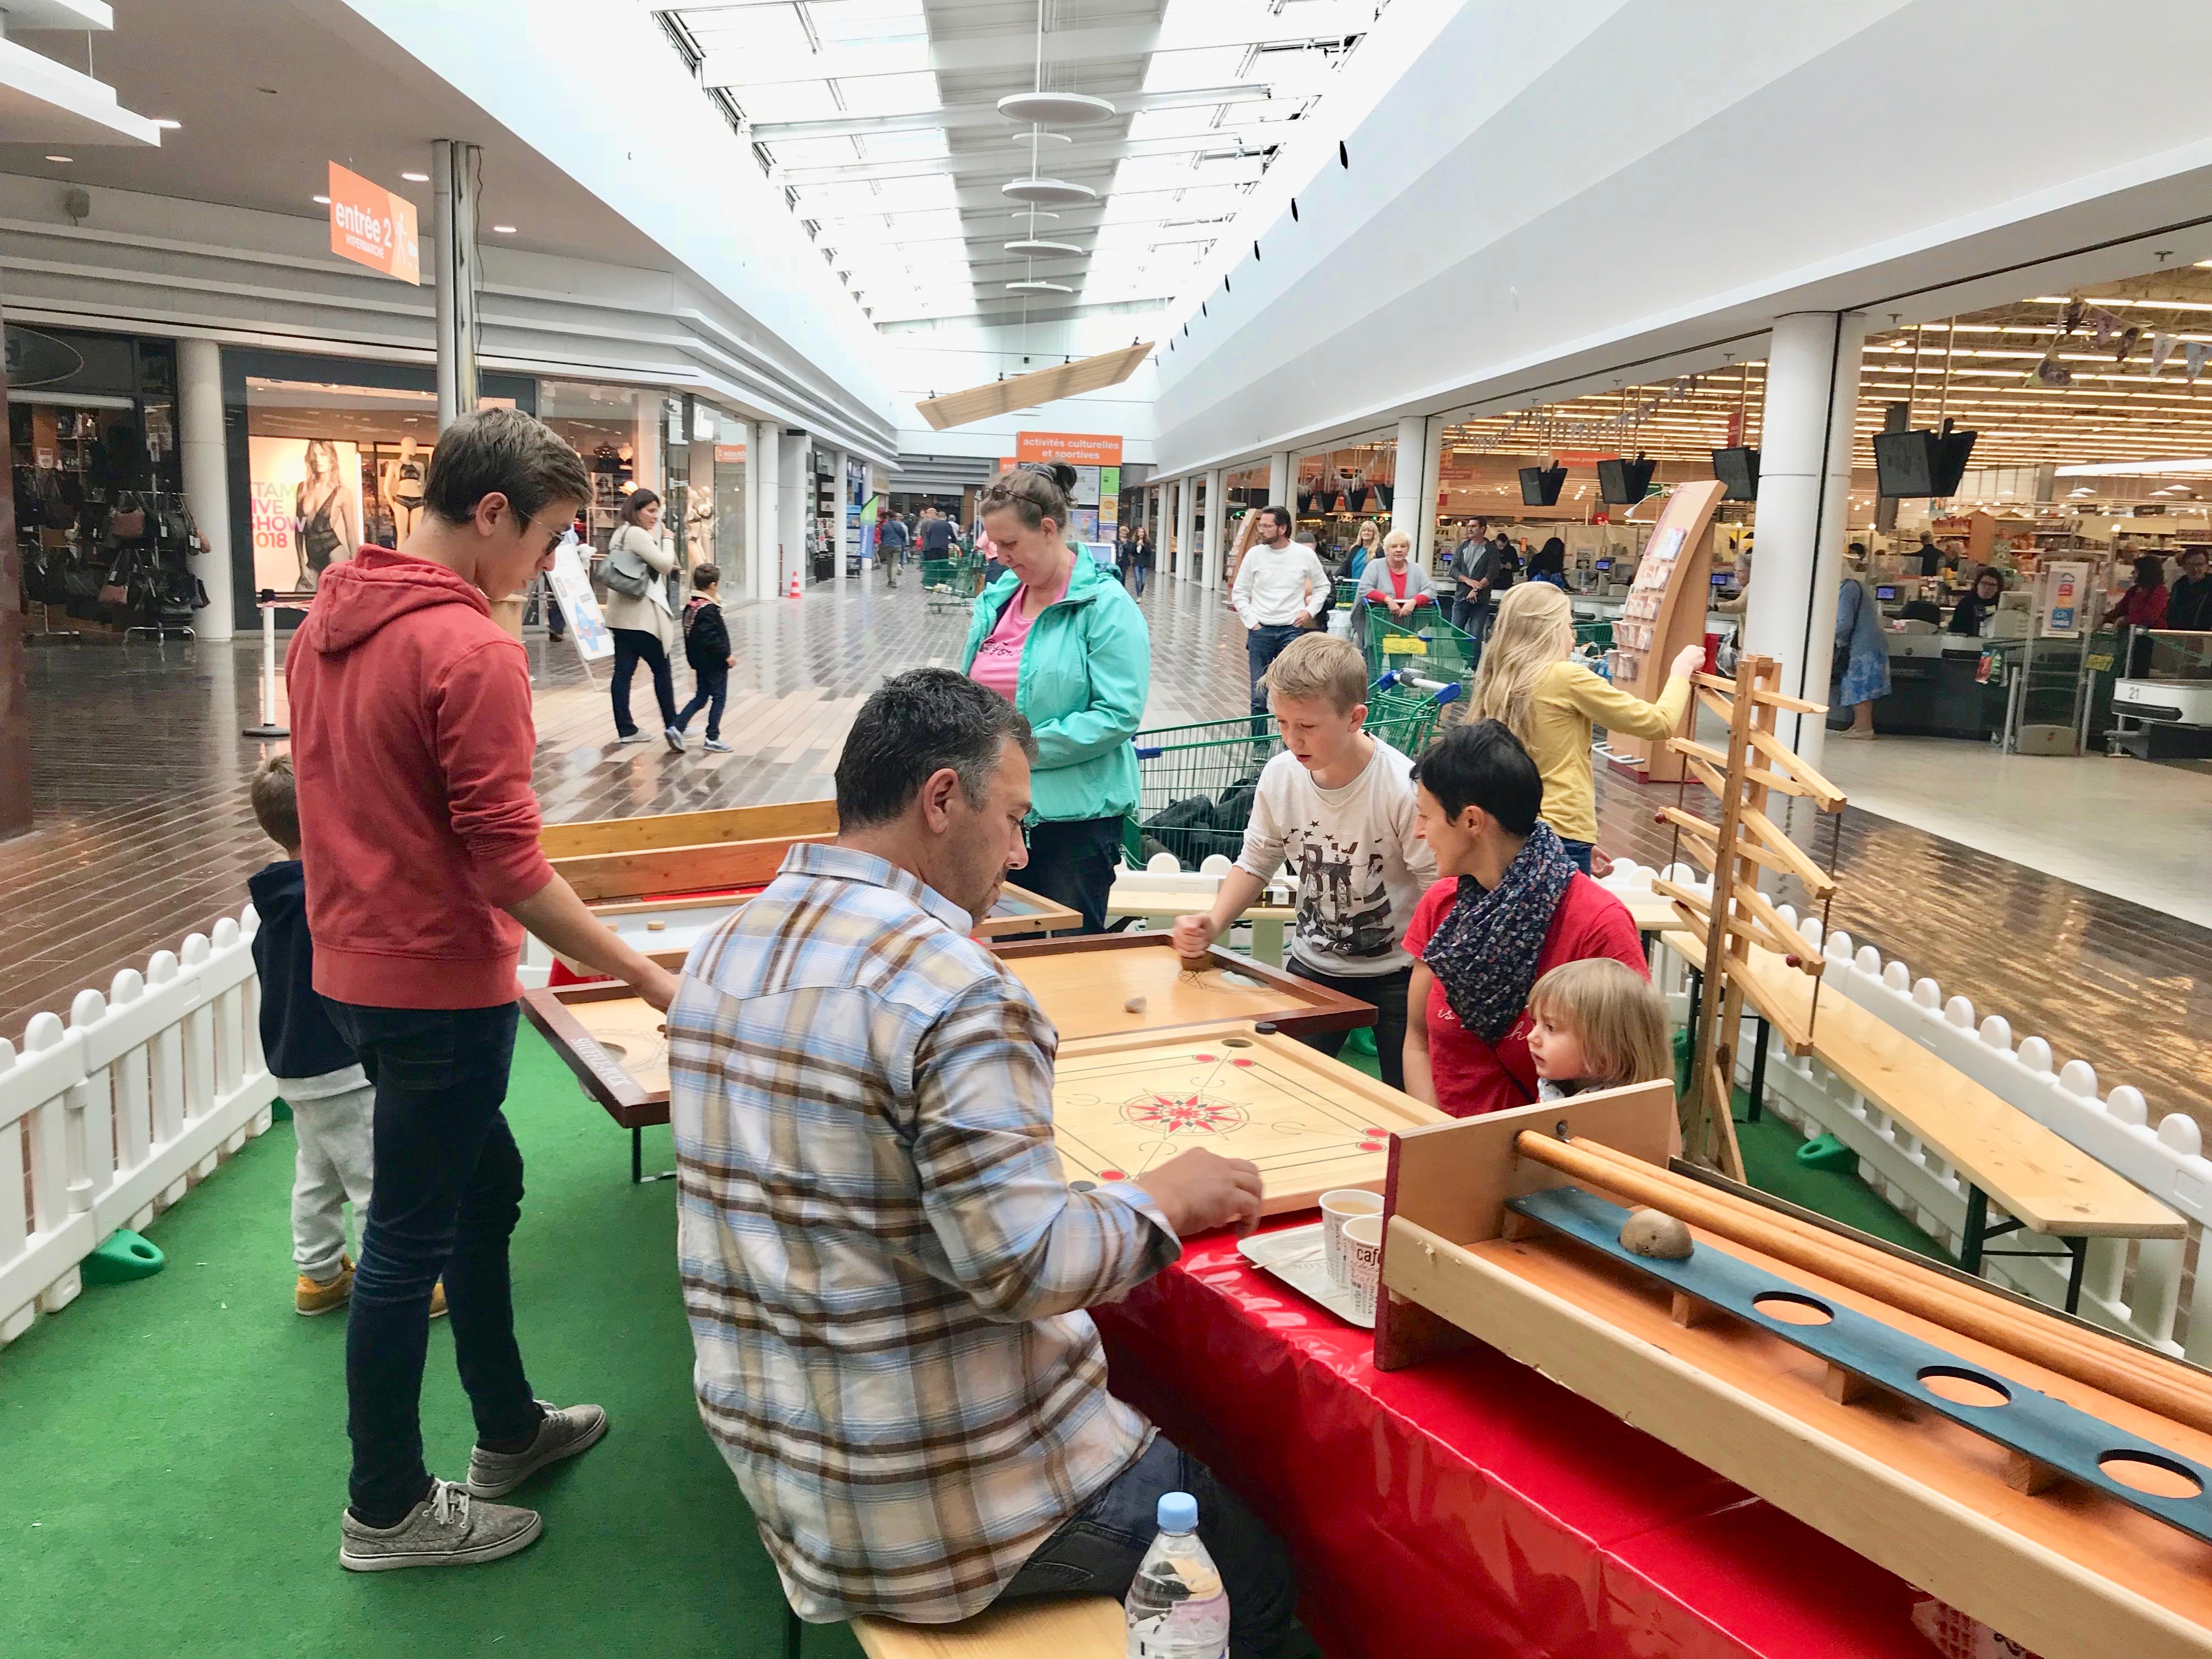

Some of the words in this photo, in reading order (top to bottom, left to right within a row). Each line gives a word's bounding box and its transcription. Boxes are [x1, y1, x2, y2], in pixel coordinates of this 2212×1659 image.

[335, 202, 381, 243] entrée
[383, 218, 392, 248] 2
[1023, 438, 1065, 447] activités
[1068, 439, 1120, 449] culturelles
[1055, 450, 1100, 459] sportives
[252, 482, 296, 498] TAM
[251, 498, 284, 515] IVE
[255, 532, 288, 548] 018
[2129, 687, 2140, 700] 21
[1357, 1249, 1380, 1266] caf
